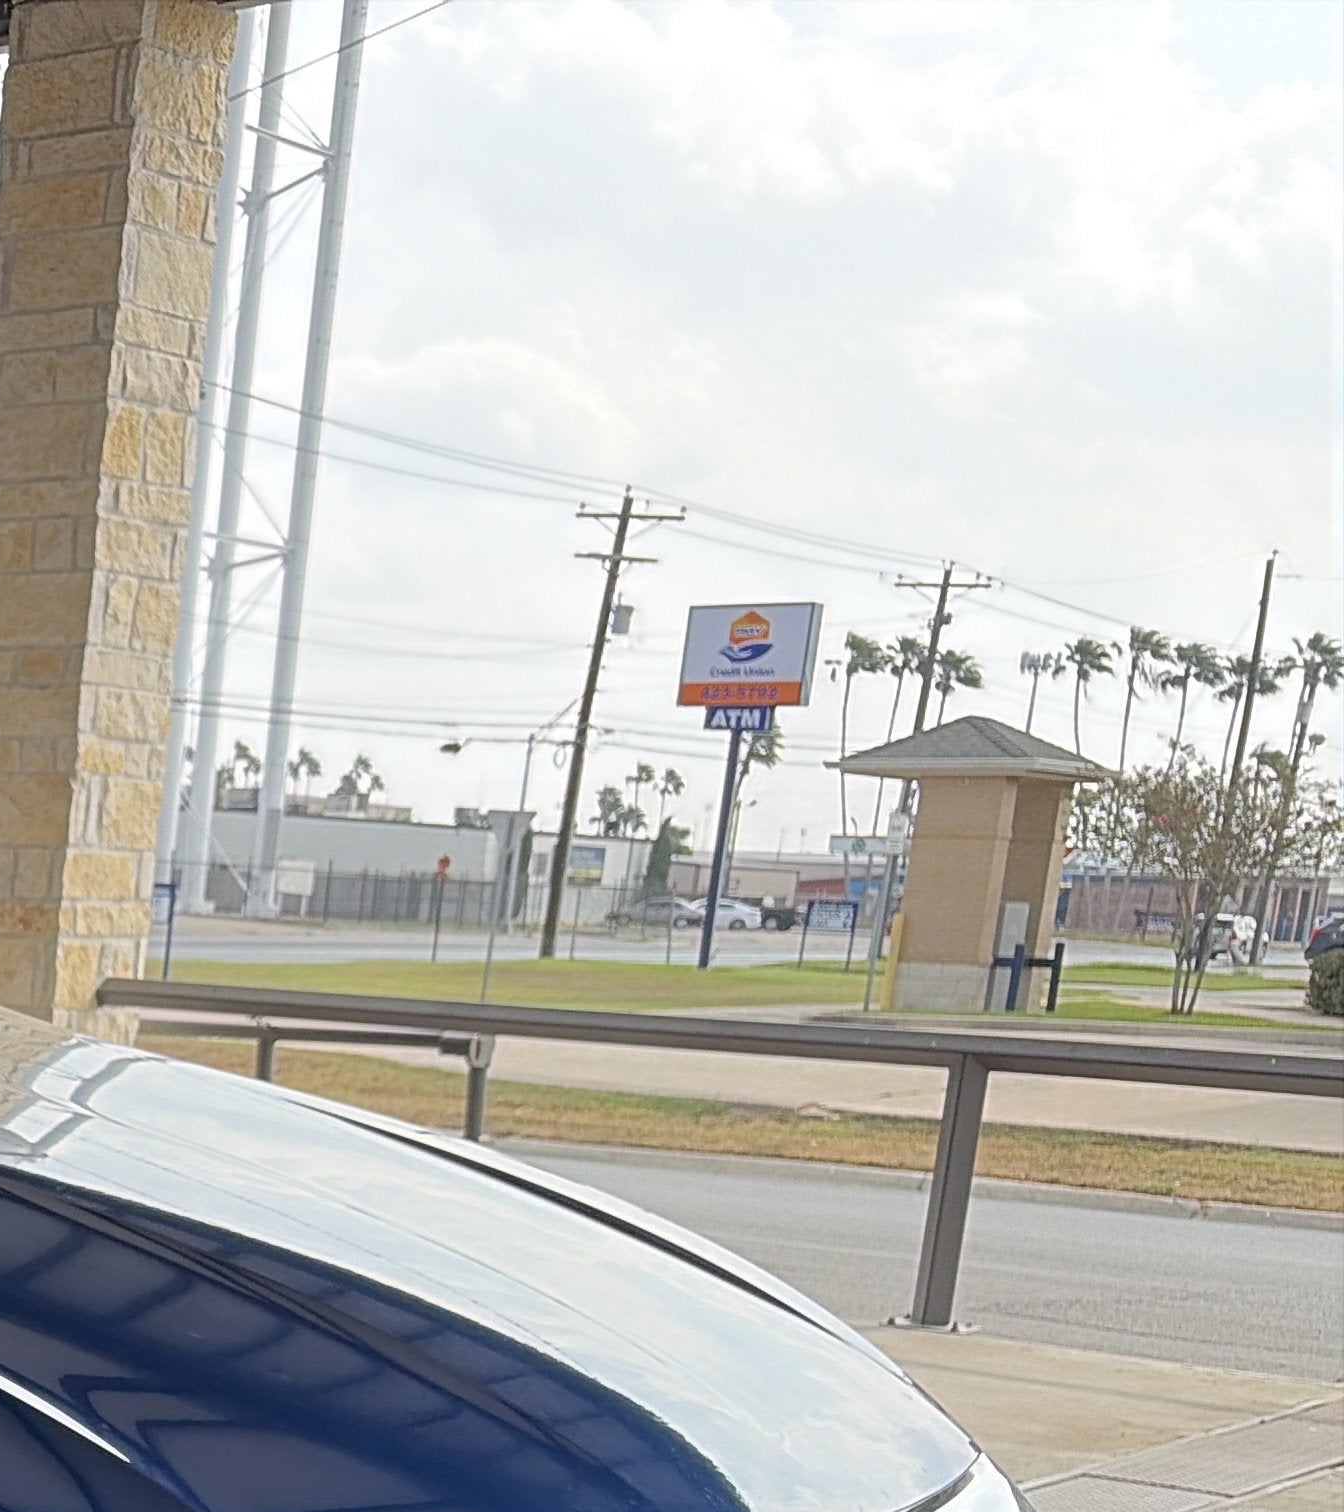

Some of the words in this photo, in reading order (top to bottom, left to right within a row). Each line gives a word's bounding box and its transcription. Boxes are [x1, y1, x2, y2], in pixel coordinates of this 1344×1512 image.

[710, 667, 740, 678] Credit
[744, 665, 775, 677] Union
[710, 708, 761, 729] ATM
